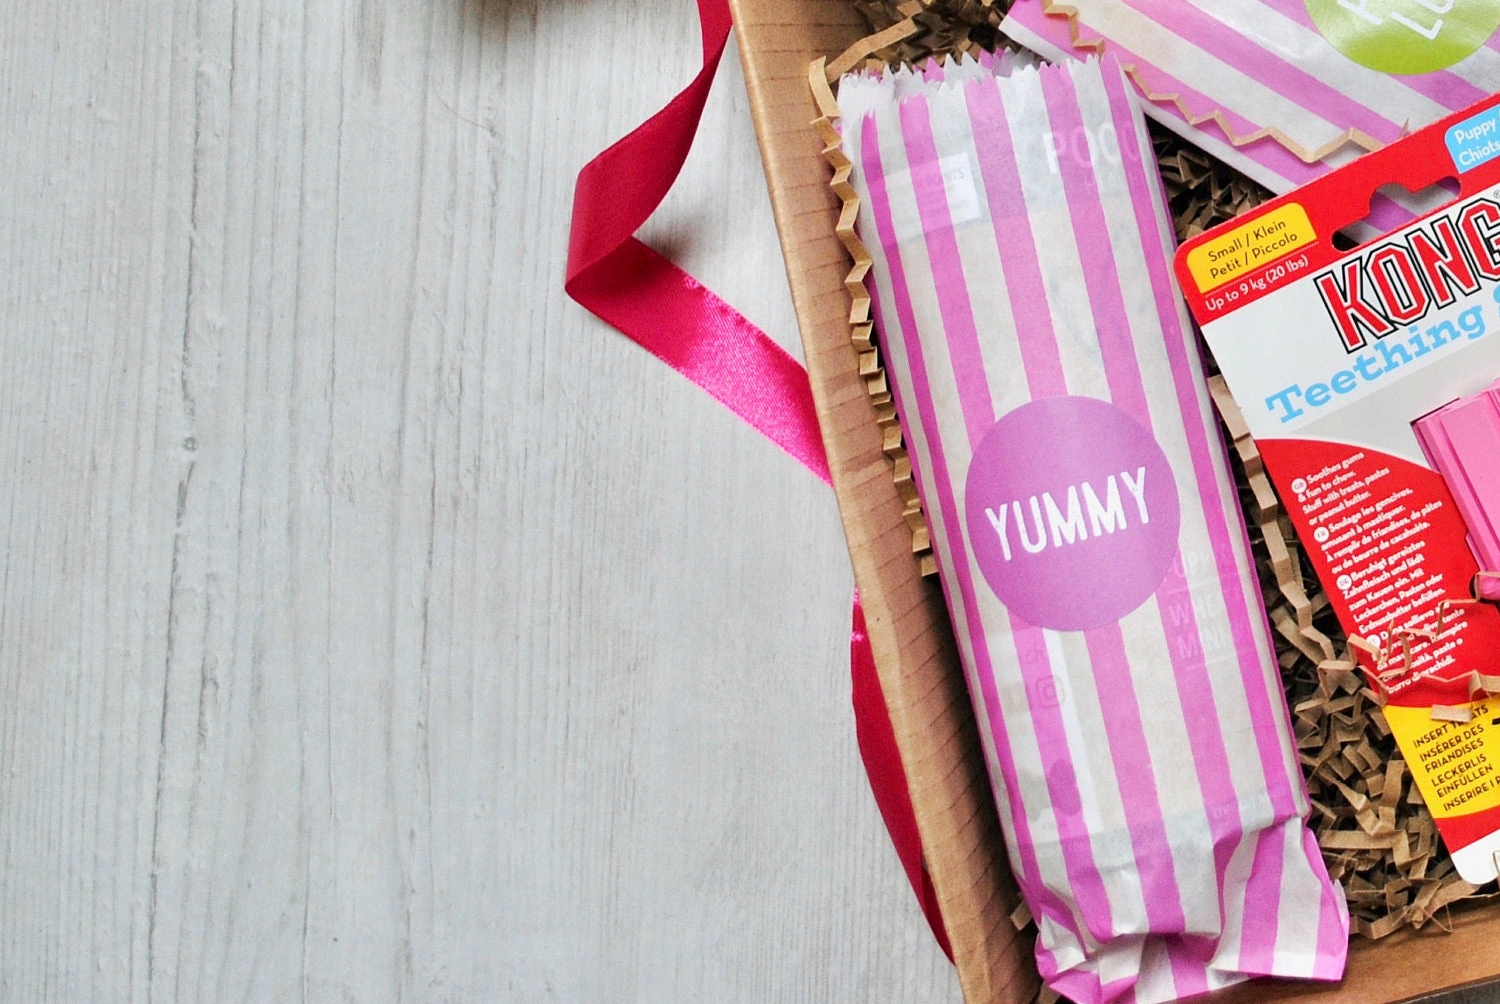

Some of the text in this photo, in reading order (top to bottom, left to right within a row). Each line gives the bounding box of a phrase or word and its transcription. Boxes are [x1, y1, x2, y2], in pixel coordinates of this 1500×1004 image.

[1454, 117, 1496, 144] Puppy
[1208, 220, 1286, 262] Small / Klein
[1210, 233, 1298, 279] Petit / Piccolo
[1205, 254, 1308, 311] Up to 9 kg (20 lbs)
[1266, 301, 1486, 424] Teething
[1307, 463, 1341, 484] Soothes
[1342, 452, 1364, 469] gums
[1302, 498, 1322, 514] Stuff
[1323, 491, 1340, 504] with
[1306, 487, 1321, 498] fun
[1321, 482, 1332, 491] to
[985, 466, 1150, 562] YUMMY
[1309, 517, 1317, 526] or
[1318, 502, 1345, 522] peanut
[1328, 512, 1361, 532] Soulage
[1361, 506, 1375, 516] les
[1333, 540, 1360, 558] remplir
[1361, 535, 1372, 544] de
[1410, 510, 1421, 520] de
[1332, 565, 1342, 574] ou
[1342, 559, 1353, 568] de
[1352, 547, 1379, 563] beurre
[1380, 540, 1390, 550] de
[1350, 558, 1388, 582] Beruhigt
[1343, 571, 1391, 600] Zahnfleisch
[1391, 561, 1407, 576] und
[1399, 583, 1425, 600] Pasten
[1426, 574, 1443, 586] oder
[1349, 598, 1367, 611] zum
[1366, 585, 1394, 602] Kauen
[1380, 626, 1403, 640] Dna
[1388, 642, 1431, 665] mascare.
[1433, 642, 1456, 658] paste
[1413, 724, 1448, 748] INSERT
[1420, 724, 1484, 762] INSÉRER DES
[1425, 738, 1484, 773] FRIANDISES
[1431, 754, 1487, 787] LECKERLIS
[1436, 764, 1494, 798] EINFÜLLEN
[1444, 782, 1489, 812] INSERIRE
[1490, 780, 1494, 788] I
